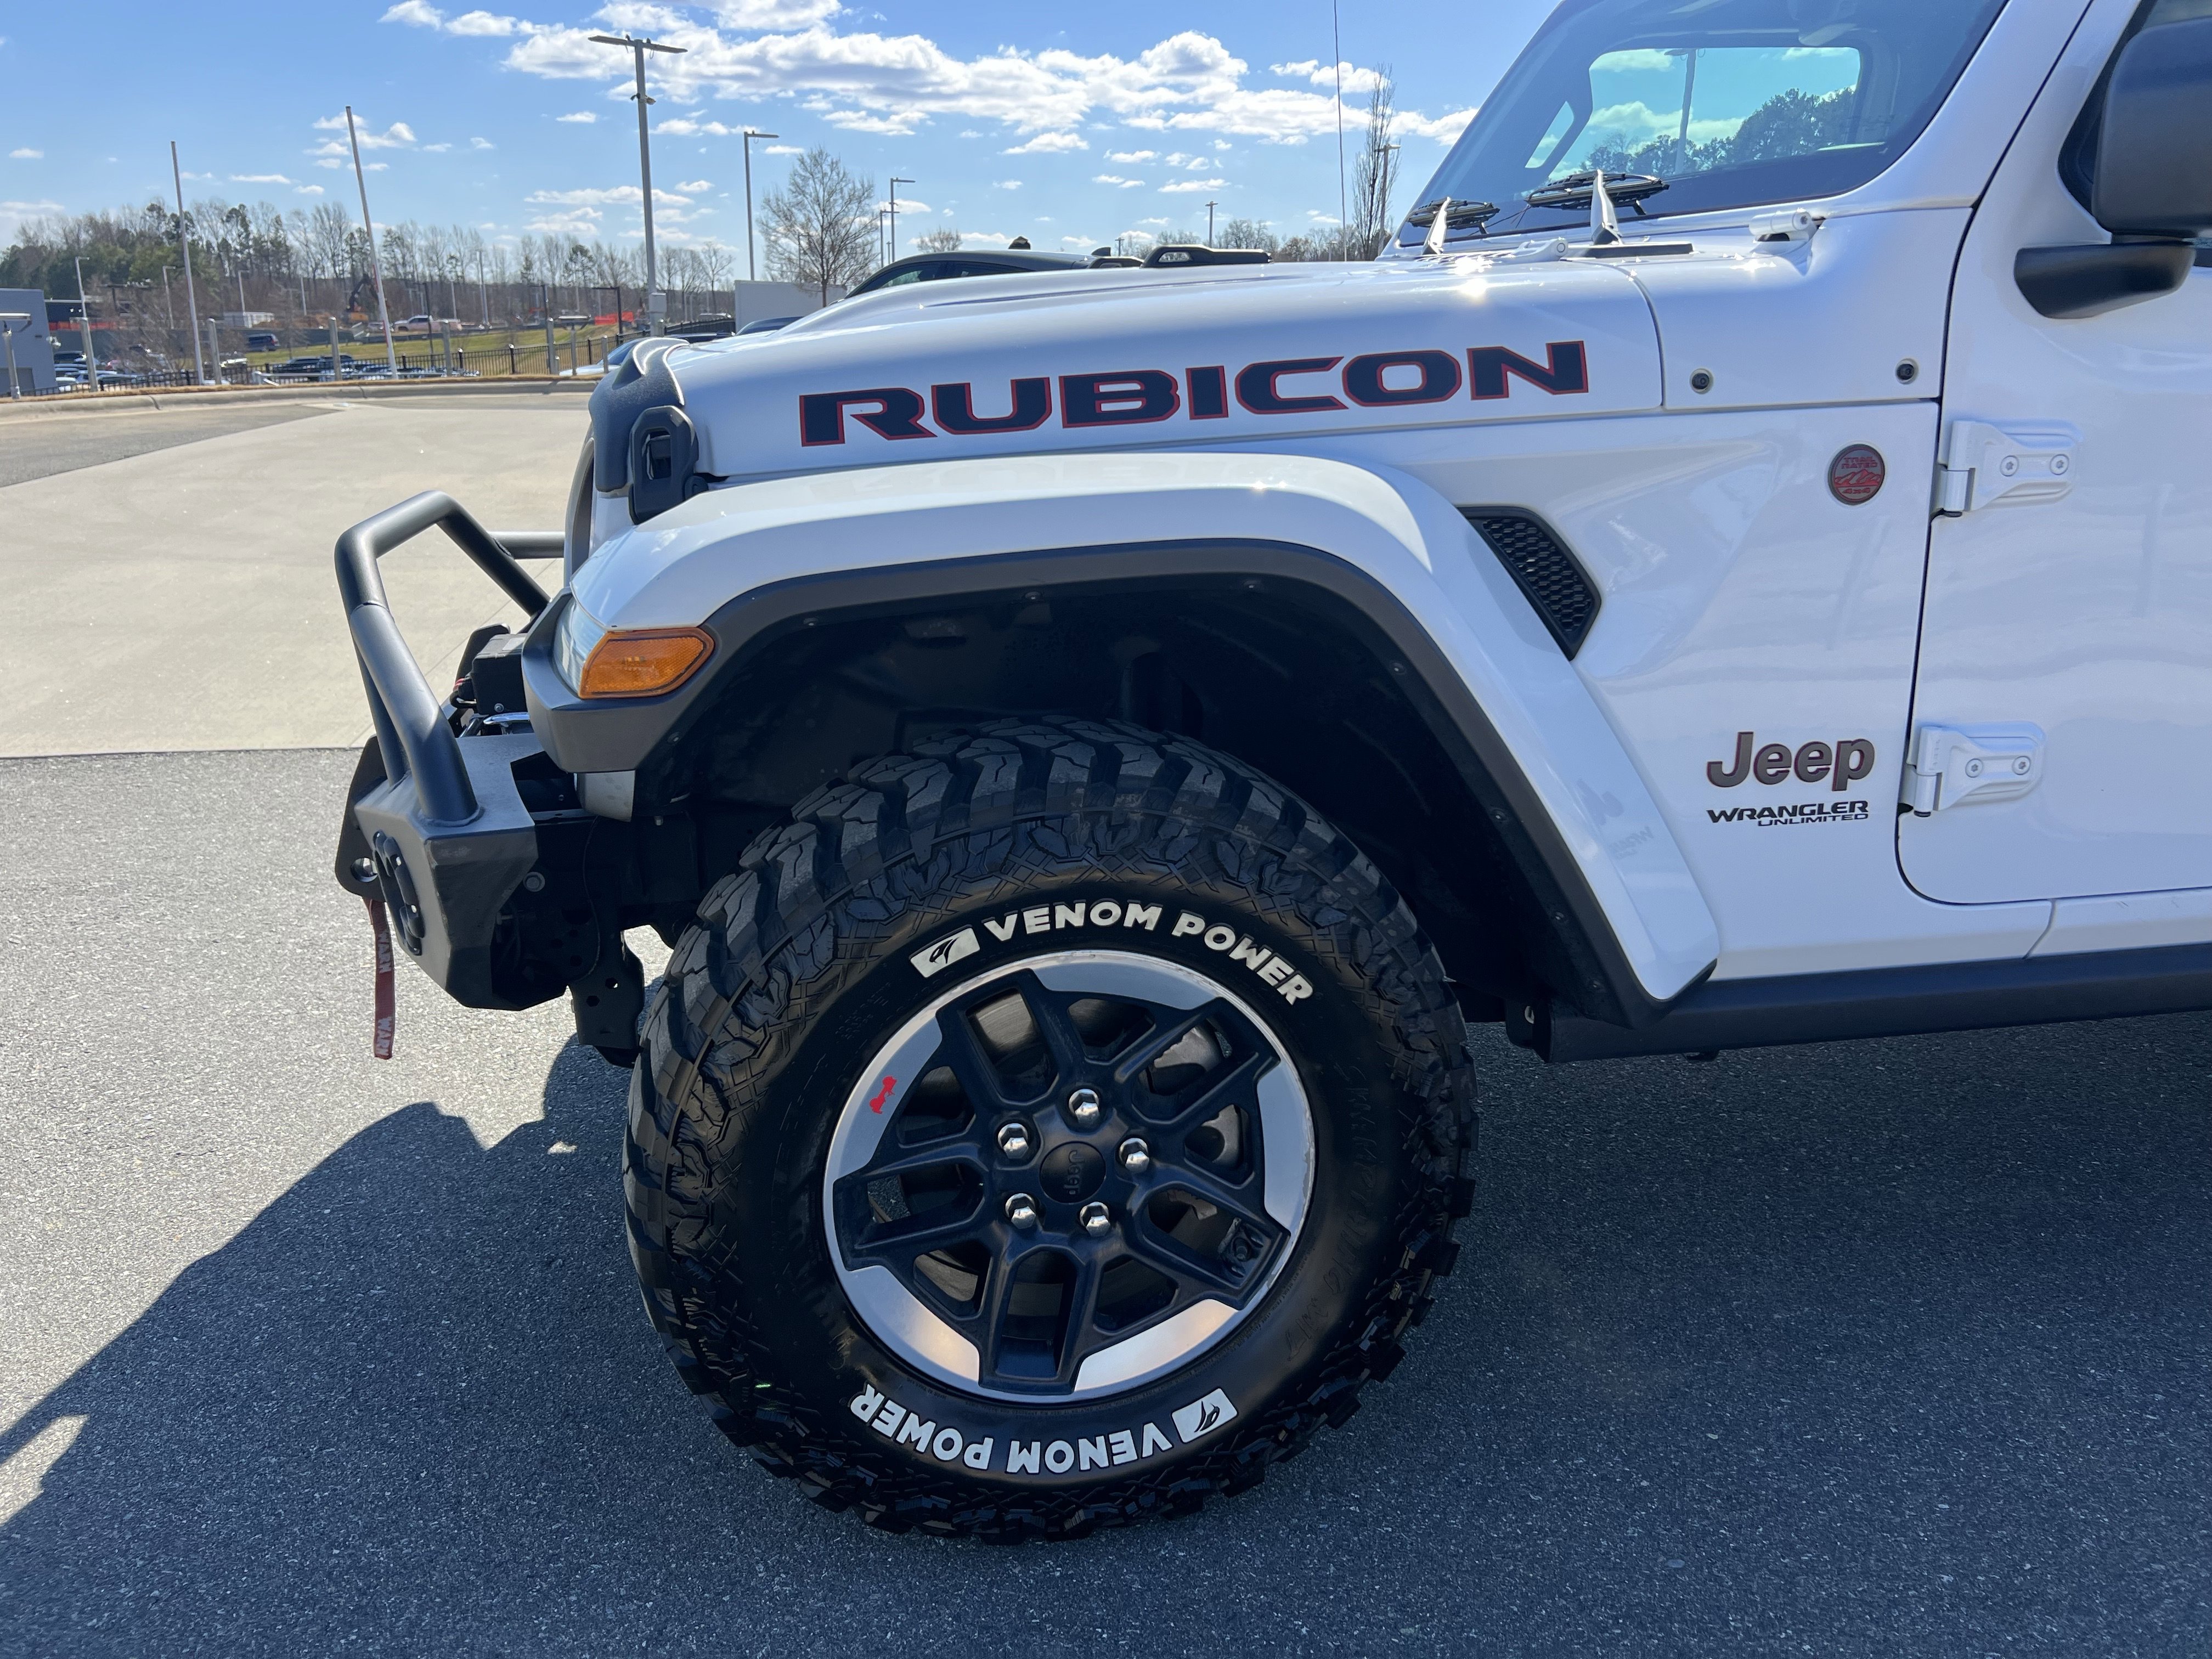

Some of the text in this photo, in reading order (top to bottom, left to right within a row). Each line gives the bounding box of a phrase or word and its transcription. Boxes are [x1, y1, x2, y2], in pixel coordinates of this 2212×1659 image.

[799, 340, 1589, 447] RUBICON
[1706, 731, 1875, 791] Jeep
[1706, 800, 1869, 823] WRANGLER
[1757, 812, 1869, 827] UNLIMITED
[983, 899, 1314, 1006] VENOM POWER
[1063, 1149, 1085, 1195] Jeep
[849, 1383, 994, 1471] POWER
[1005, 1421, 1173, 1474] VENOM
